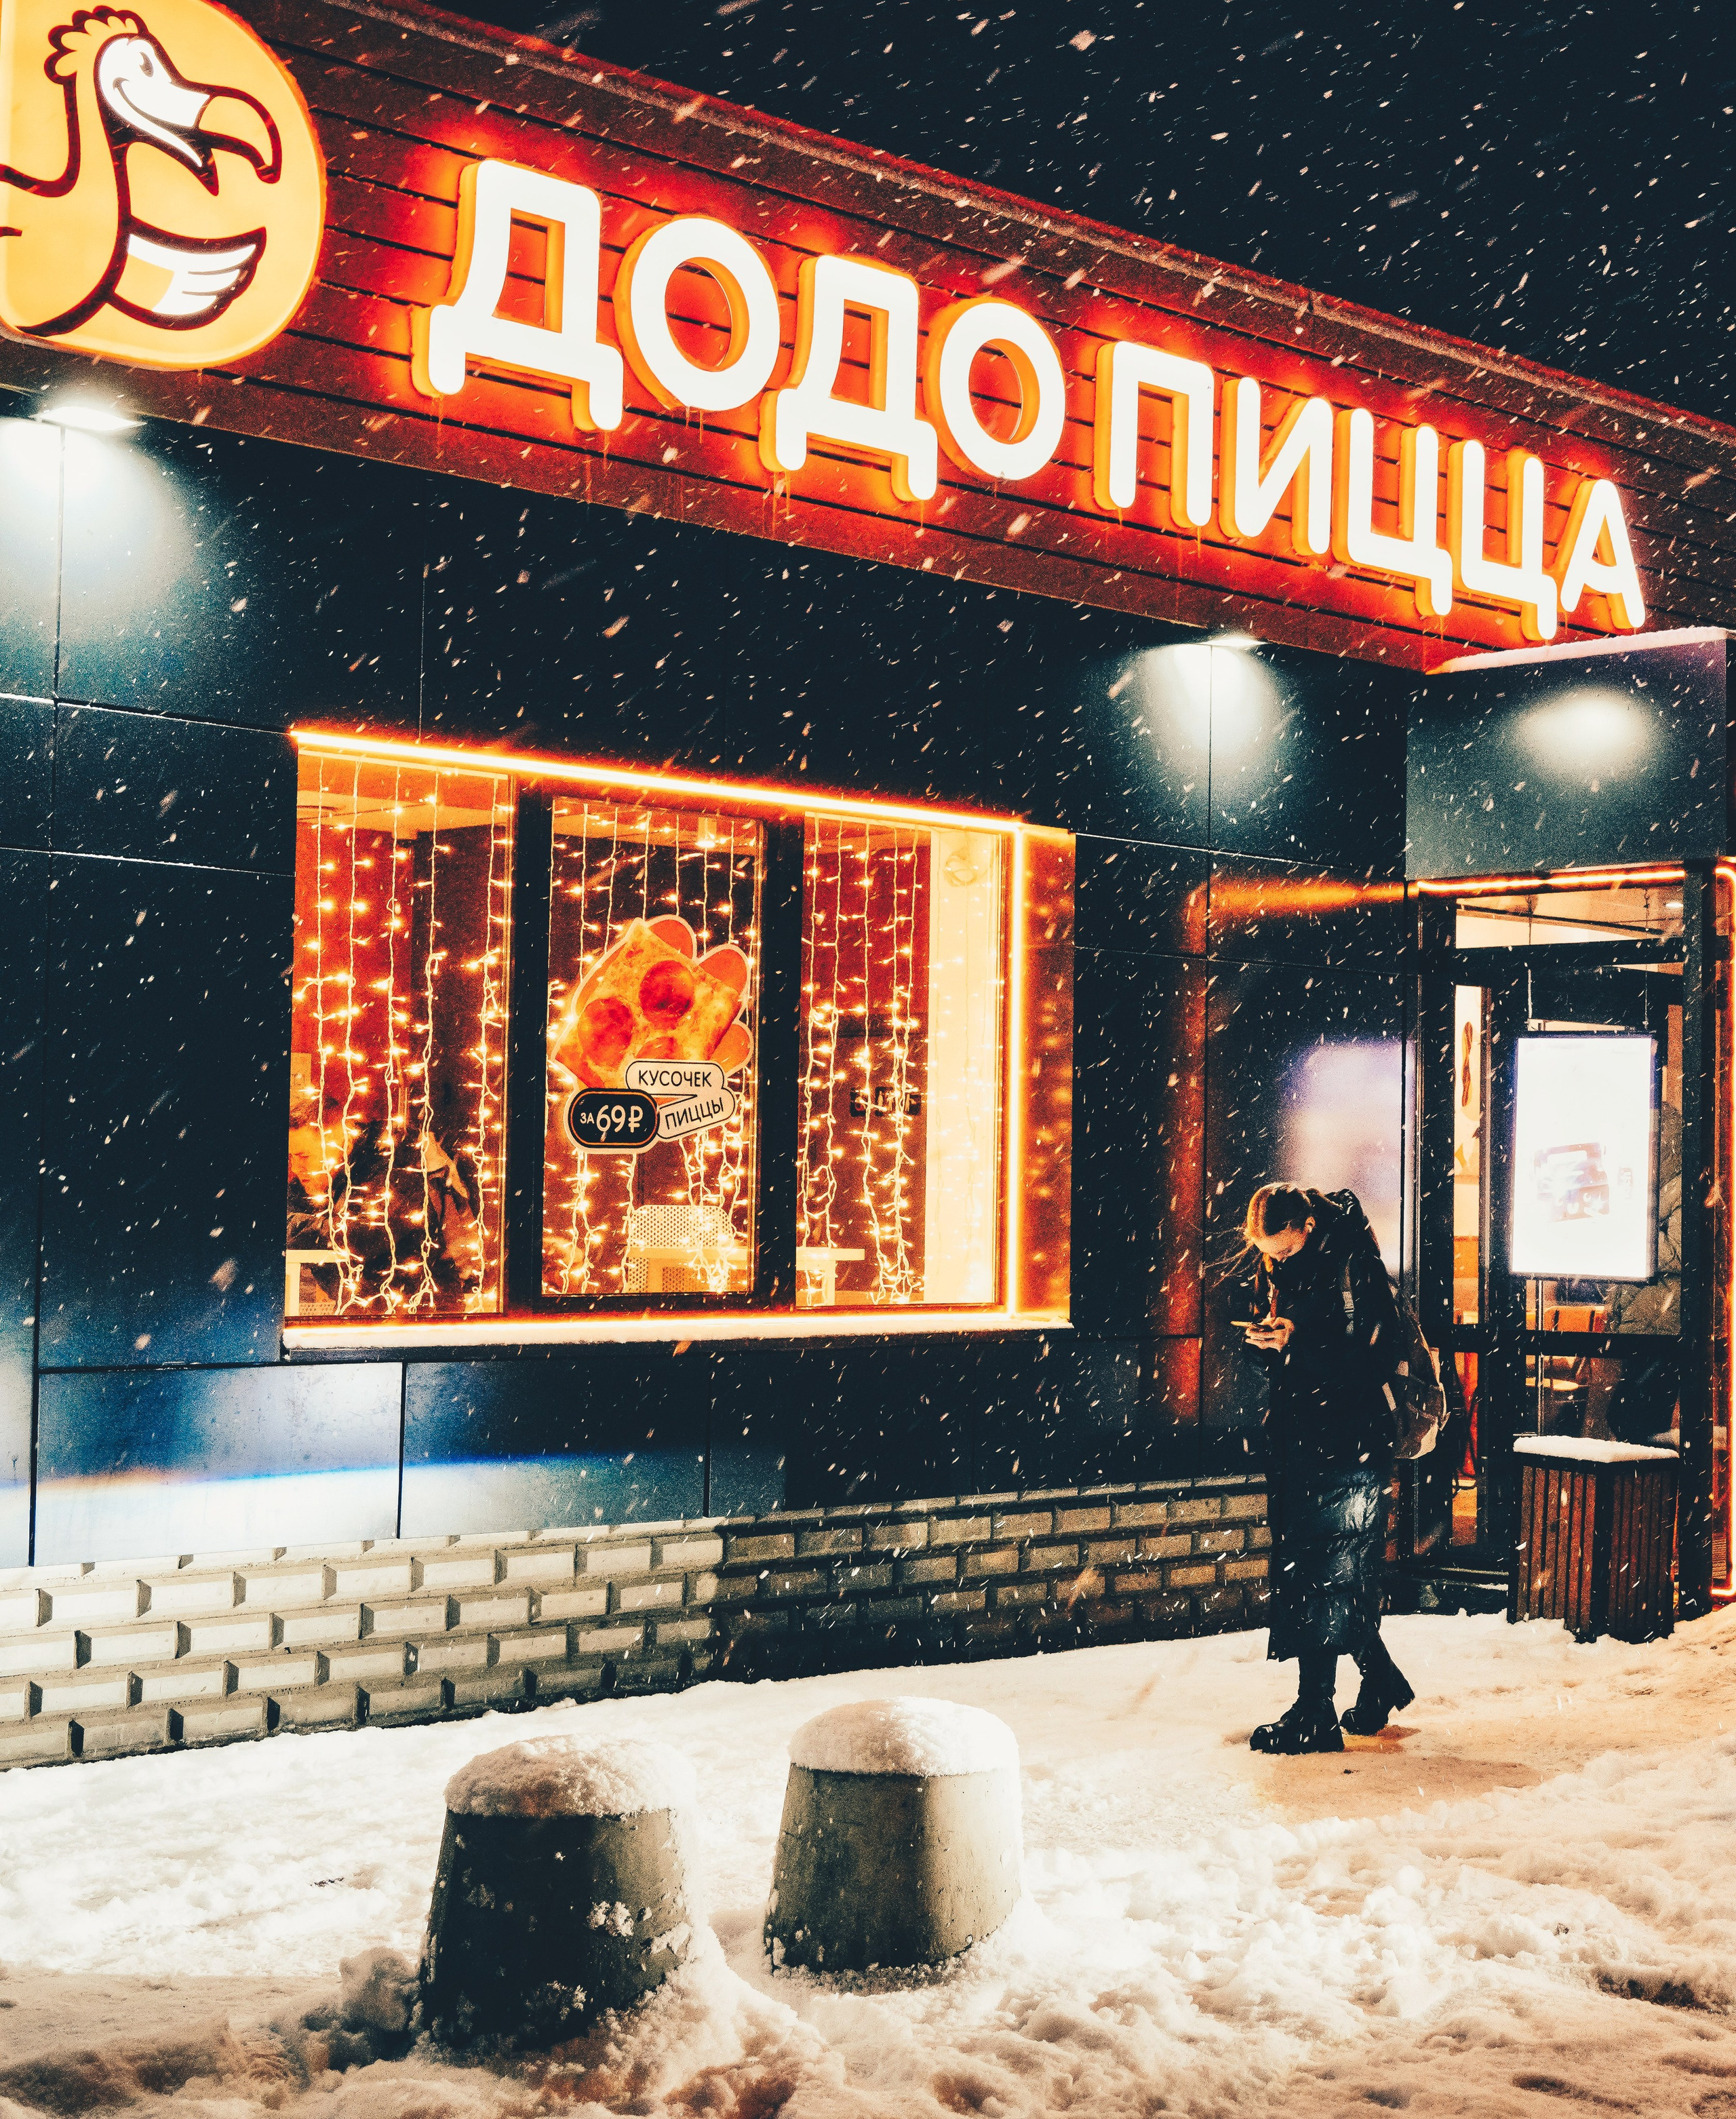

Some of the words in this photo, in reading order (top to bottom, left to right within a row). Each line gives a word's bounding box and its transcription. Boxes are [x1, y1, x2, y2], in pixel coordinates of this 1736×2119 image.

[427, 158, 1067, 501] ДОДО
[1107, 340, 1646, 640] ПИЦЦА
[638, 1069, 712, 1087] КУСОЧЕК
[665, 1096, 724, 1130] ПИЦЦЫ
